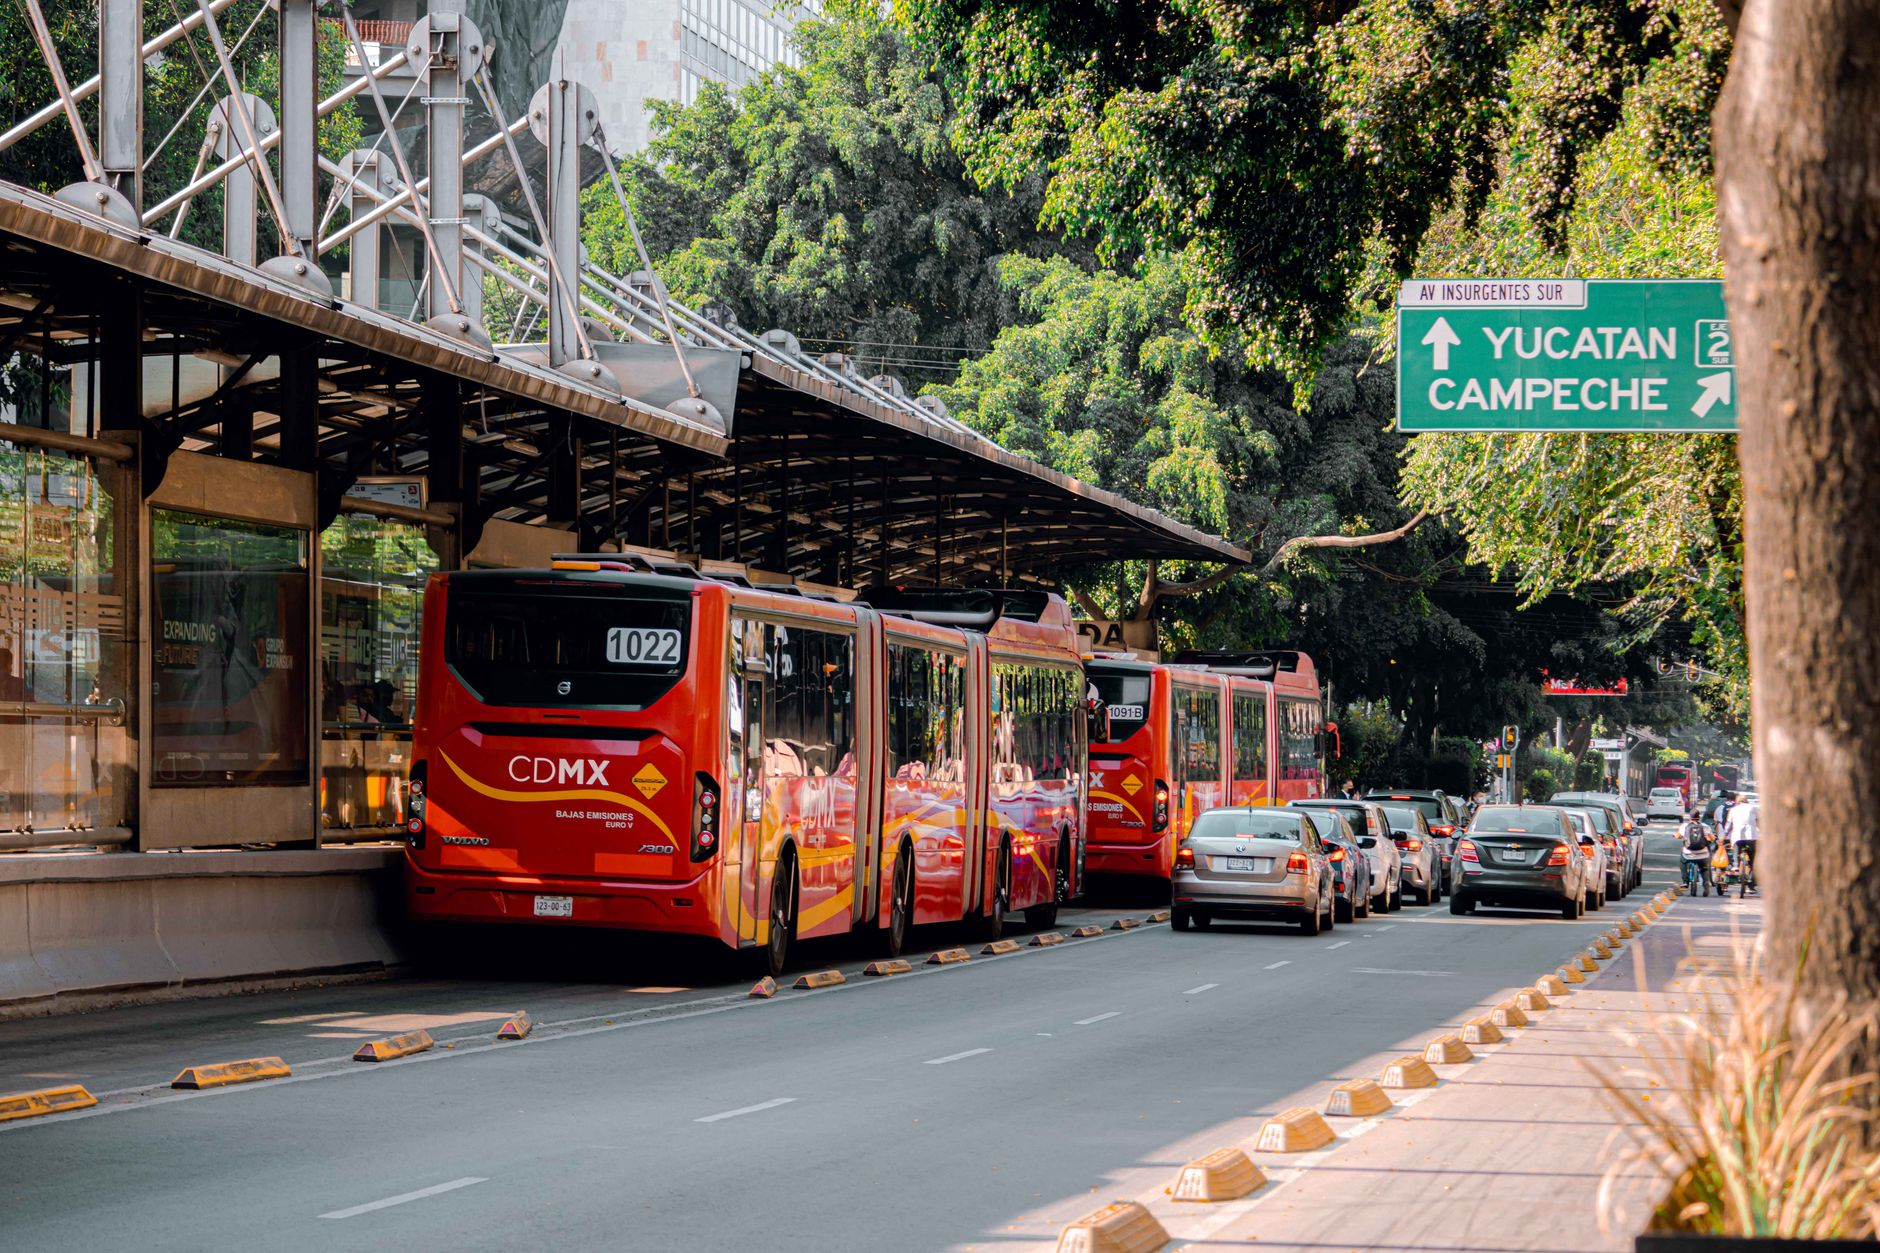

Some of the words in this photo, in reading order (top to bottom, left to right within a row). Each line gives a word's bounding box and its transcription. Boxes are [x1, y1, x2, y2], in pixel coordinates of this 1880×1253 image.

[1419, 283, 1435, 301] AV
[1441, 283, 1531, 301] INSURGENTES
[1536, 283, 1563, 301] SUR
[1482, 326, 1677, 360] YUCATAN
[1707, 331, 1729, 357] 2
[1427, 377, 1669, 412] CAMPECHE
[163, 620, 217, 642] EXPANDING
[609, 629, 678, 662] 1022
[508, 754, 610, 786] CDMX
[555, 810, 585, 819] BAJAS
[586, 811, 634, 821] EMISIONES
[1093, 803, 1124, 812] EMISIONES
[605, 821, 626, 829] EURO
[441, 835, 490, 846] VOLVO
[536, 901, 571, 912] 123-00-63
